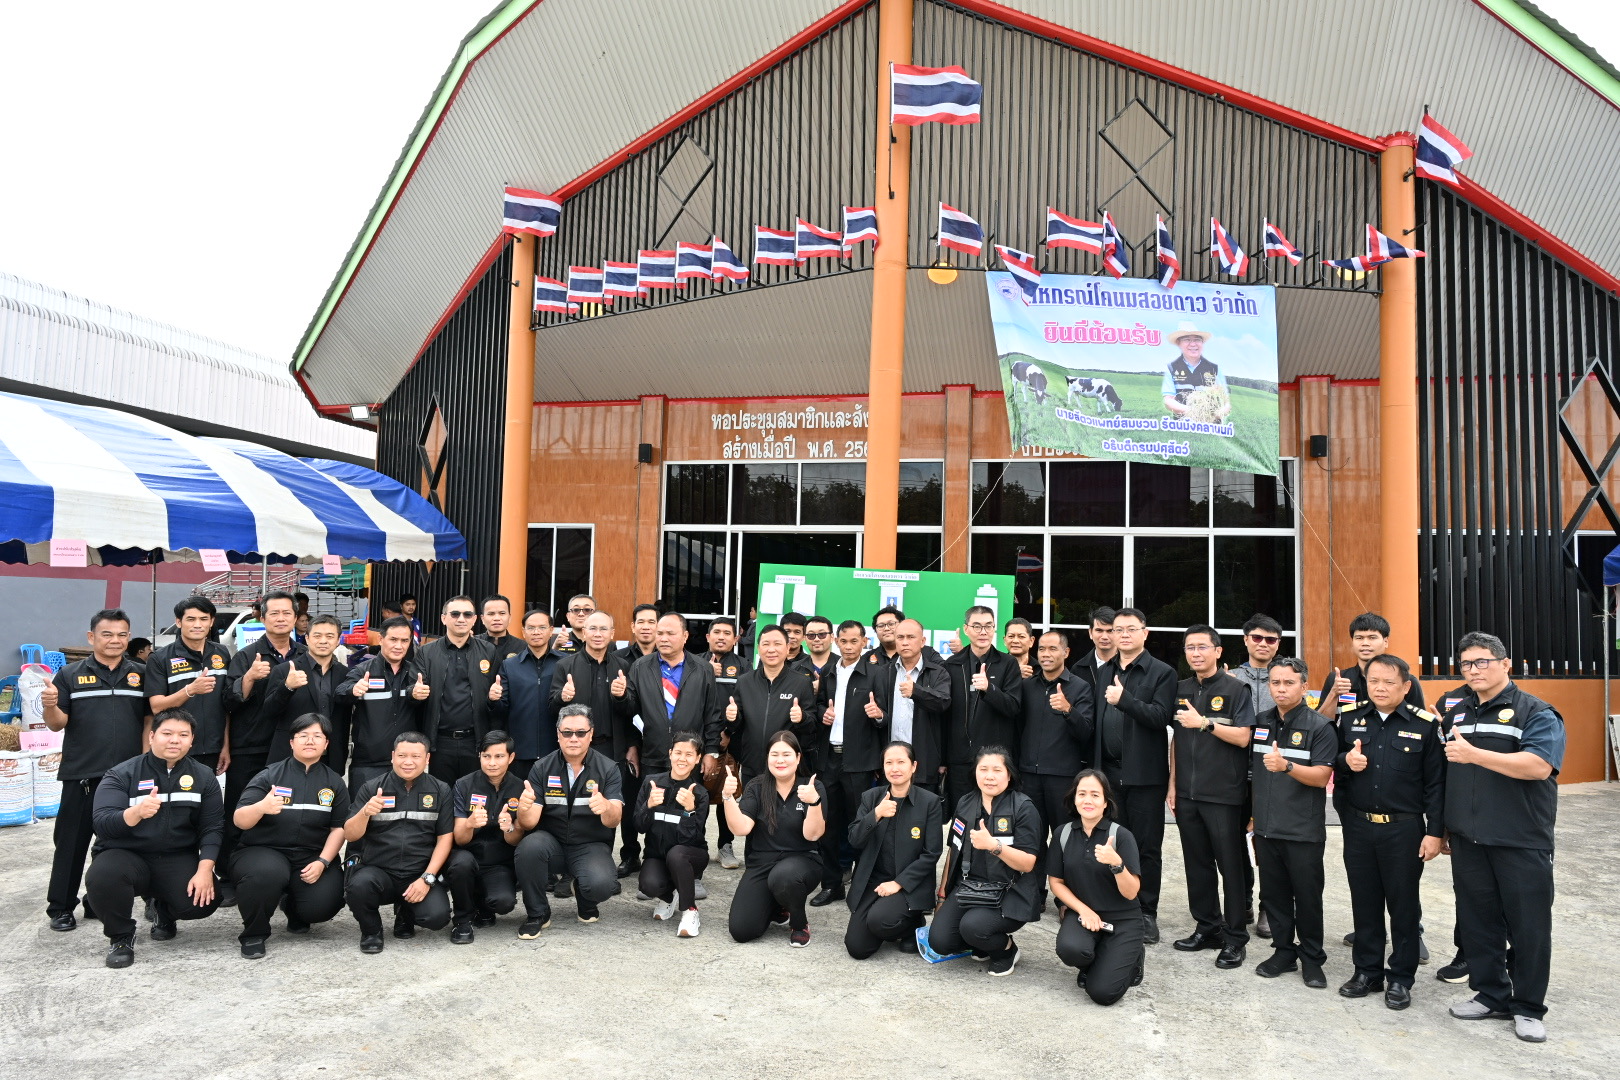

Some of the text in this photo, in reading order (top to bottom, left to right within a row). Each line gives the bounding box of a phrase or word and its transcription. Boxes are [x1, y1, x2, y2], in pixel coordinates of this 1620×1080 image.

[1213, 290, 1258, 316] จำกัด
[1044, 320, 1161, 346] ยินดีต้อนรับ
[1056, 407, 1158, 429] นายสัตวแพทย์สมชวน
[722, 429, 796, 459] สร้างเมื่อปี
[807, 440, 837, 458] พ.ศ.
[1103, 439, 1189, 458] อธิบดีกรมปศุสัตว์
[77, 675, 97, 684] DLD
